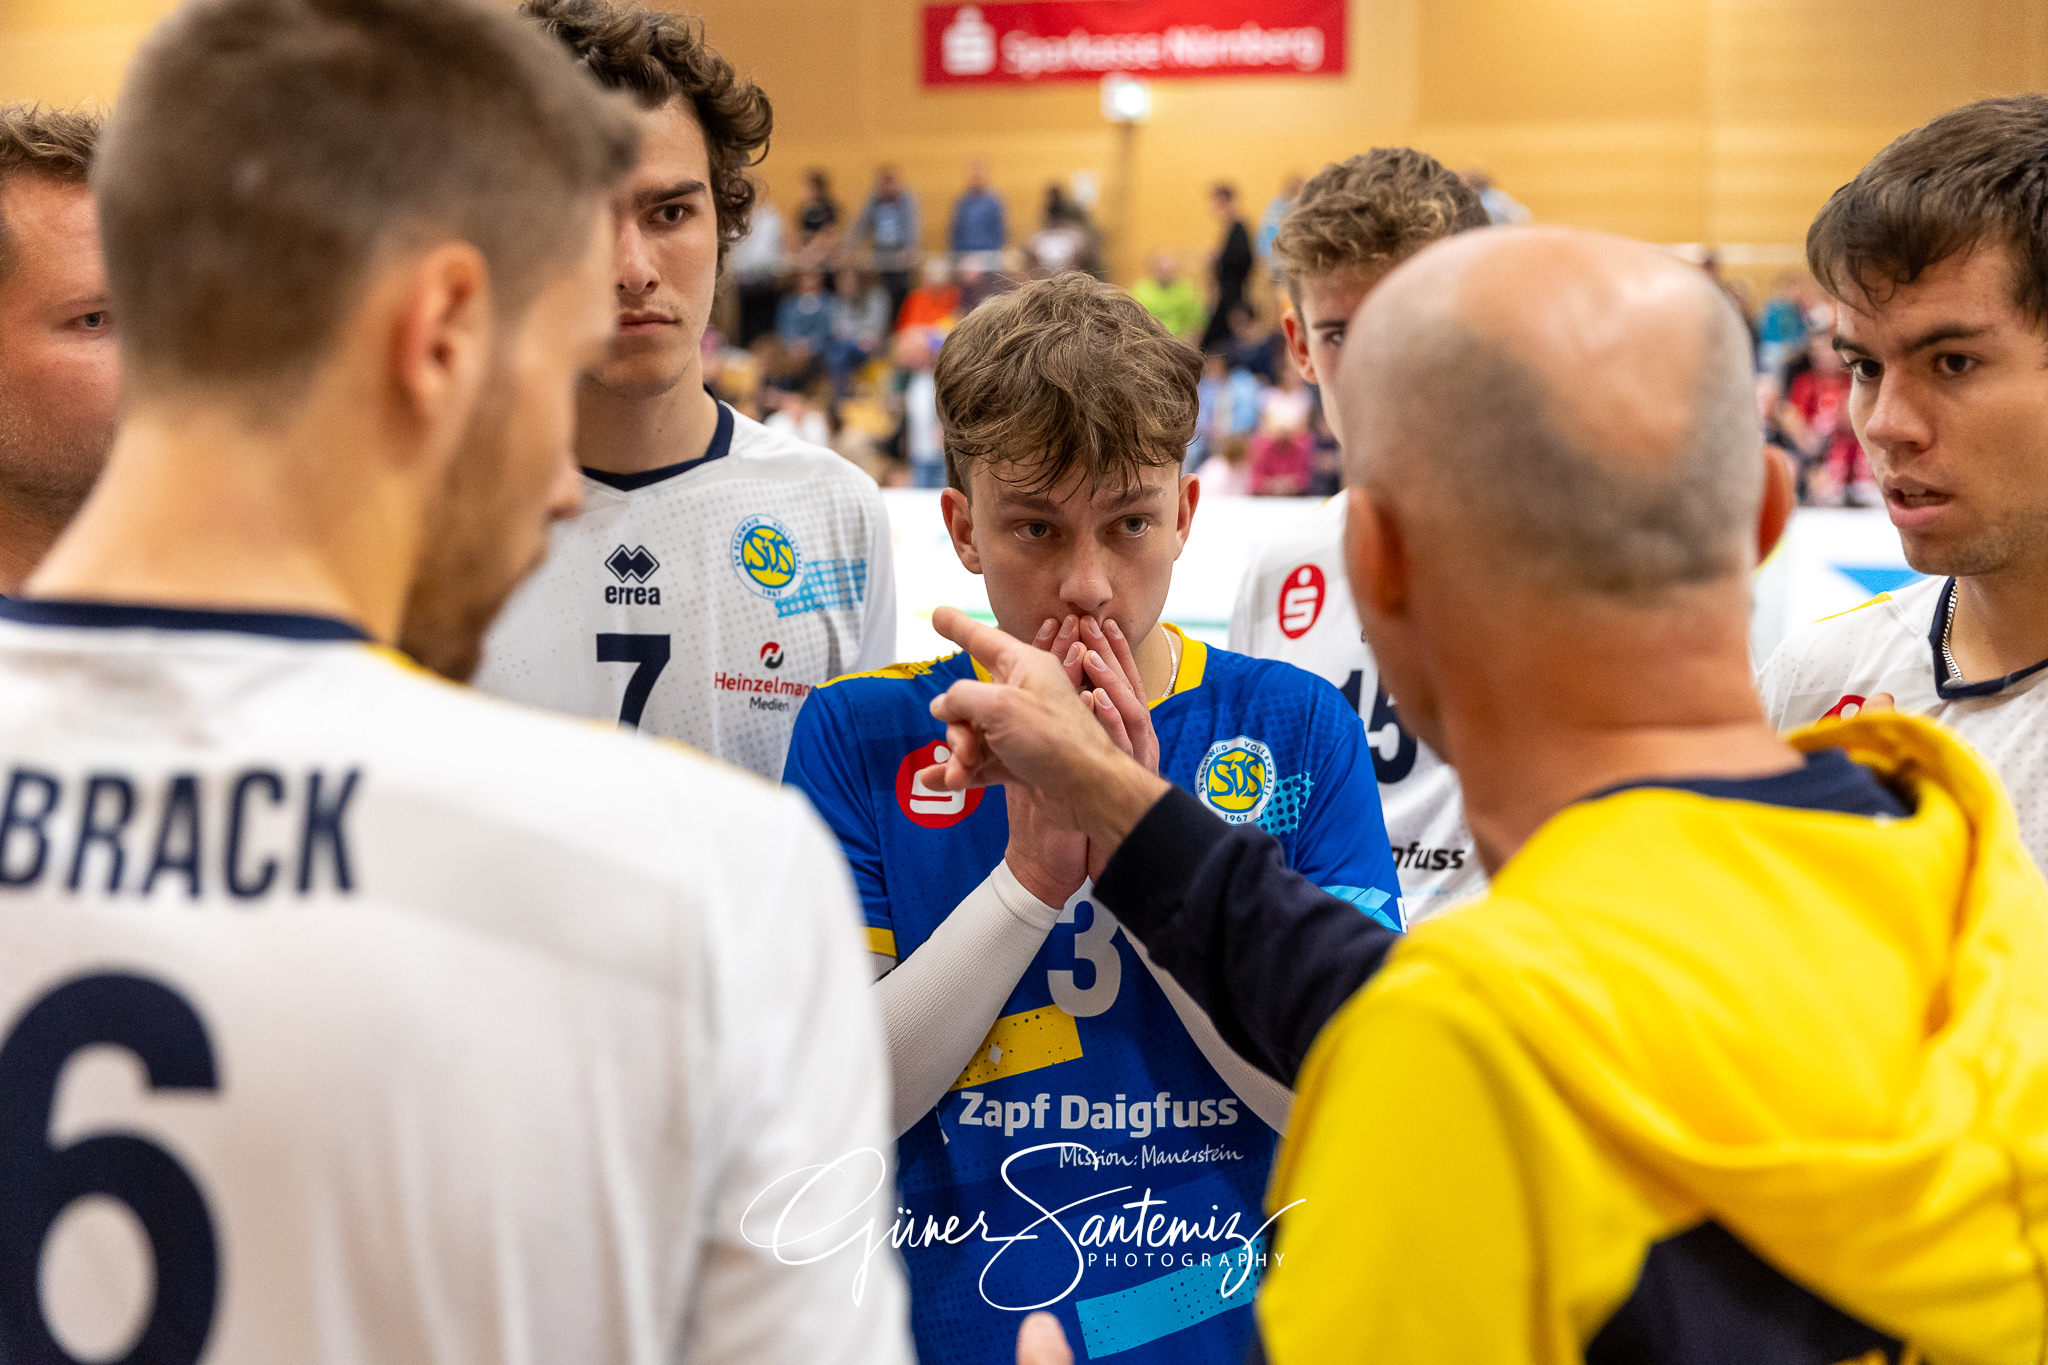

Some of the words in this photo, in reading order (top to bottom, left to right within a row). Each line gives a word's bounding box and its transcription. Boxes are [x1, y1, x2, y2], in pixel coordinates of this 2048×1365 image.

[604, 584, 661, 605] errea
[596, 632, 671, 736] 7
[714, 671, 813, 697] Heinzelman
[749, 696, 790, 711] Medien
[0, 766, 362, 898] BRACK
[1224, 813, 1248, 822] 1967
[1047, 876, 1122, 1018] 3
[959, 1091, 1050, 1137] Zapf
[1060, 1092, 1239, 1138] Daigfuss
[0, 968, 223, 1365] 6
[1059, 1145, 1138, 1168] Mission:
